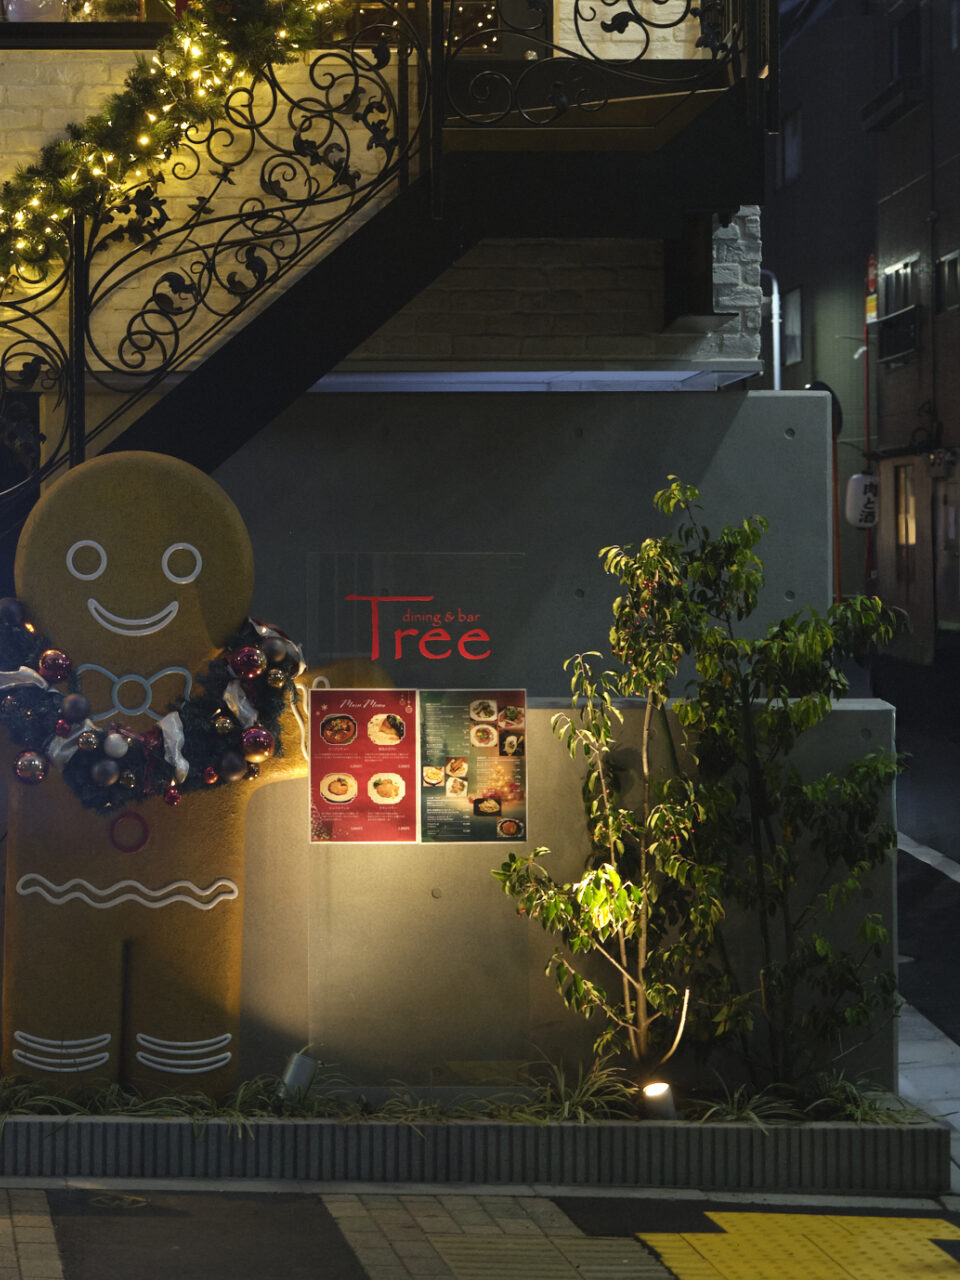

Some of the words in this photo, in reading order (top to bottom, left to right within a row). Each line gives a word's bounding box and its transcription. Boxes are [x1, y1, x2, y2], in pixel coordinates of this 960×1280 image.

[859, 481, 878, 524] 肉と酒
[344, 594, 491, 661] Tree
[402, 608, 442, 627] dining
[444, 611, 455, 623] &
[458, 608, 481, 622] bar
